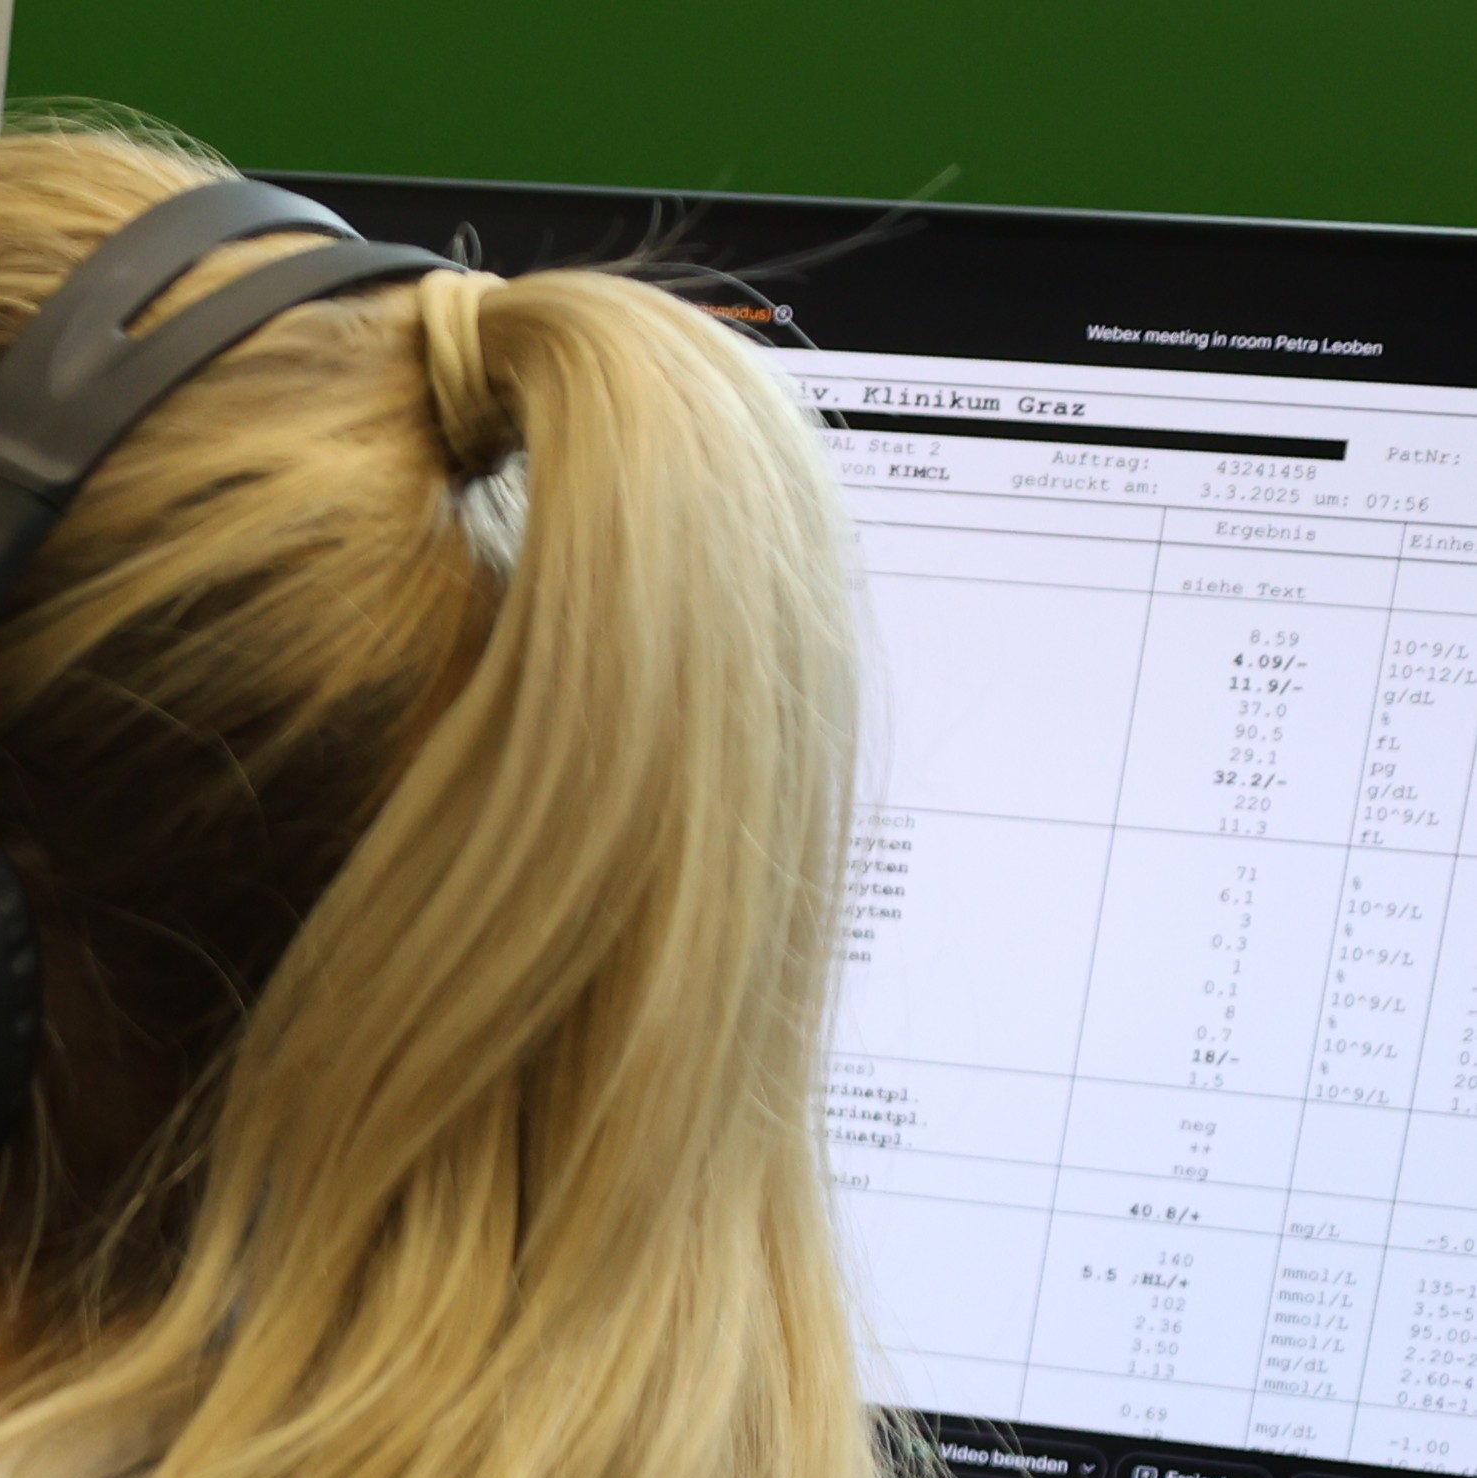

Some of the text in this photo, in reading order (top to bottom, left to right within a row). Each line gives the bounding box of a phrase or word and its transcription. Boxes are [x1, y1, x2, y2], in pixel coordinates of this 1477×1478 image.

[1086, 324, 1384, 356] Webex meeting in room Petra Leoben
[861, 386, 1086, 418] Klinikum Graz
[868, 438, 915, 455] Stat
[1385, 446, 1461, 466] PatNr:
[1051, 450, 1150, 474] Auftrag:
[1010, 472, 1159, 496] gedruckt am:
[1200, 482, 1430, 513] 3.3.2025 um: 07:56
[1214, 520, 1317, 543] Ergebnis
[1182, 578, 1307, 599] siehe Text
[1249, 628, 1300, 648] 8.59
[1234, 795, 1271, 812] 220
[1178, 1118, 1218, 1136] neg
[938, 1441, 1069, 1475] Video beenden
